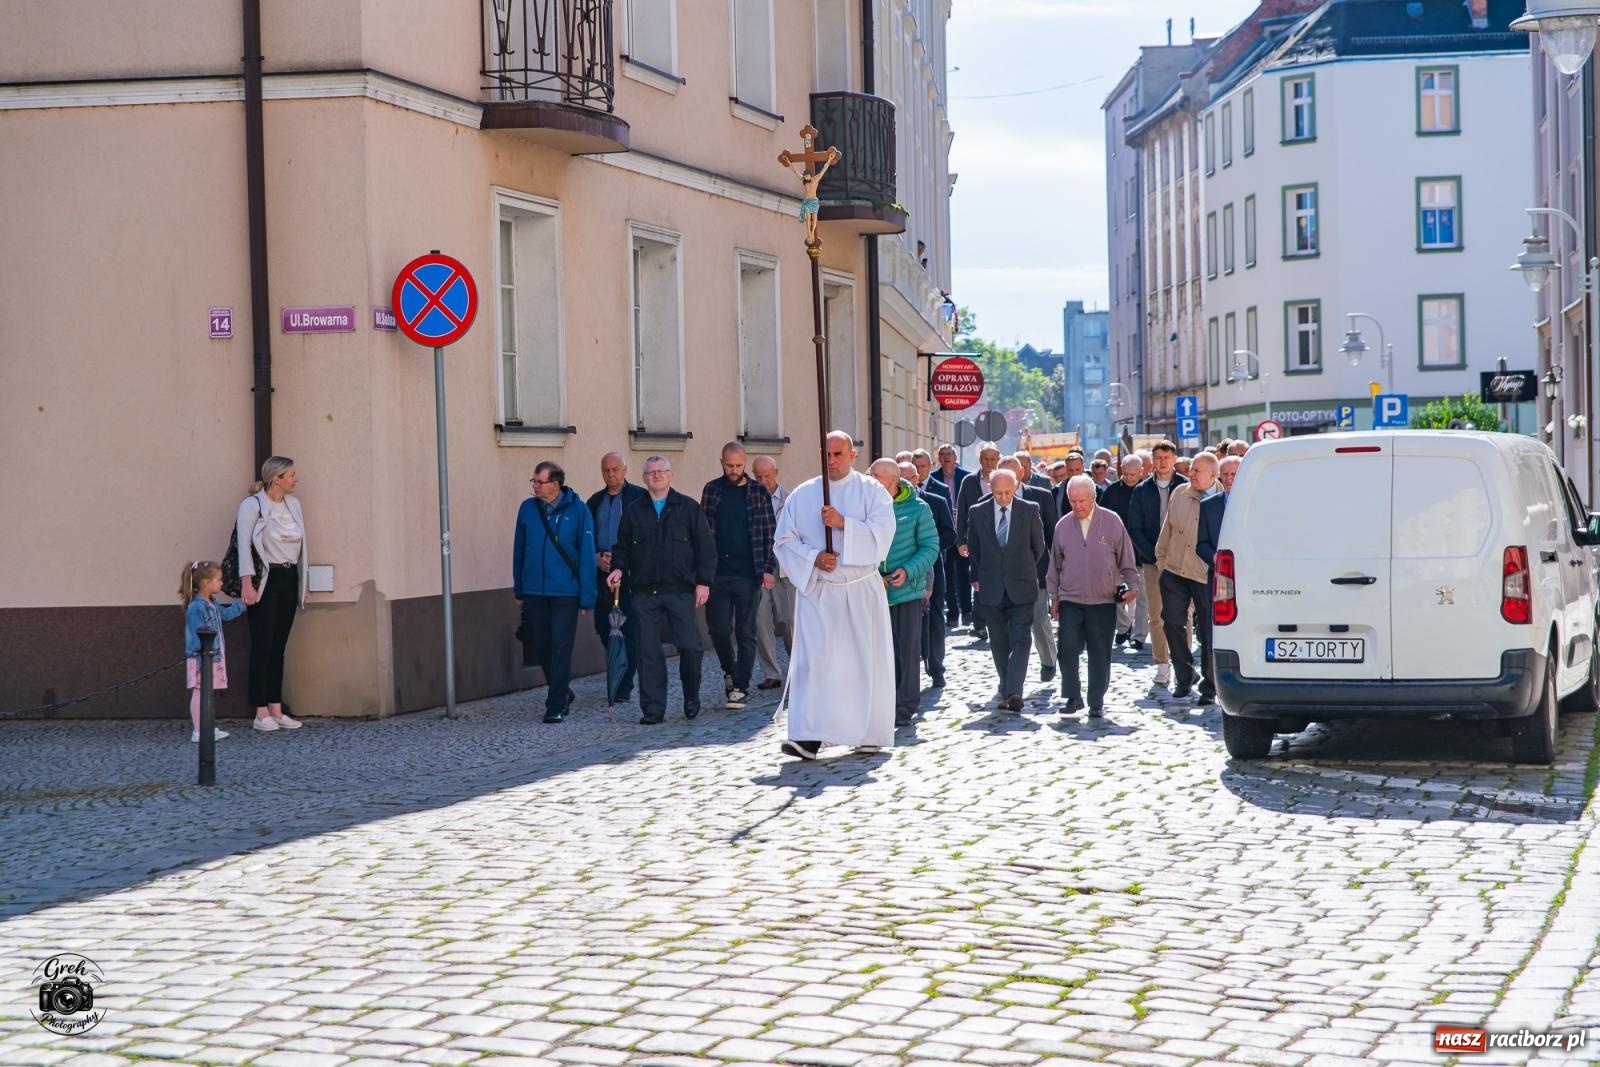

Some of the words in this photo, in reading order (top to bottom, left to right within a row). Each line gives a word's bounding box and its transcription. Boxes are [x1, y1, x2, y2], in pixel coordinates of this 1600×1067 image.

[212, 317, 230, 331] 14
[290, 313, 348, 327] Ul.Browarna
[938, 374, 977, 383] OPRAWA
[934, 383, 981, 392] OBRAZÓW
[1342, 406, 1351, 418] P
[1382, 397, 1402, 423] P
[1182, 419, 1195, 436] P
[1277, 641, 1298, 657] S2
[1305, 641, 1360, 658] TORTY
